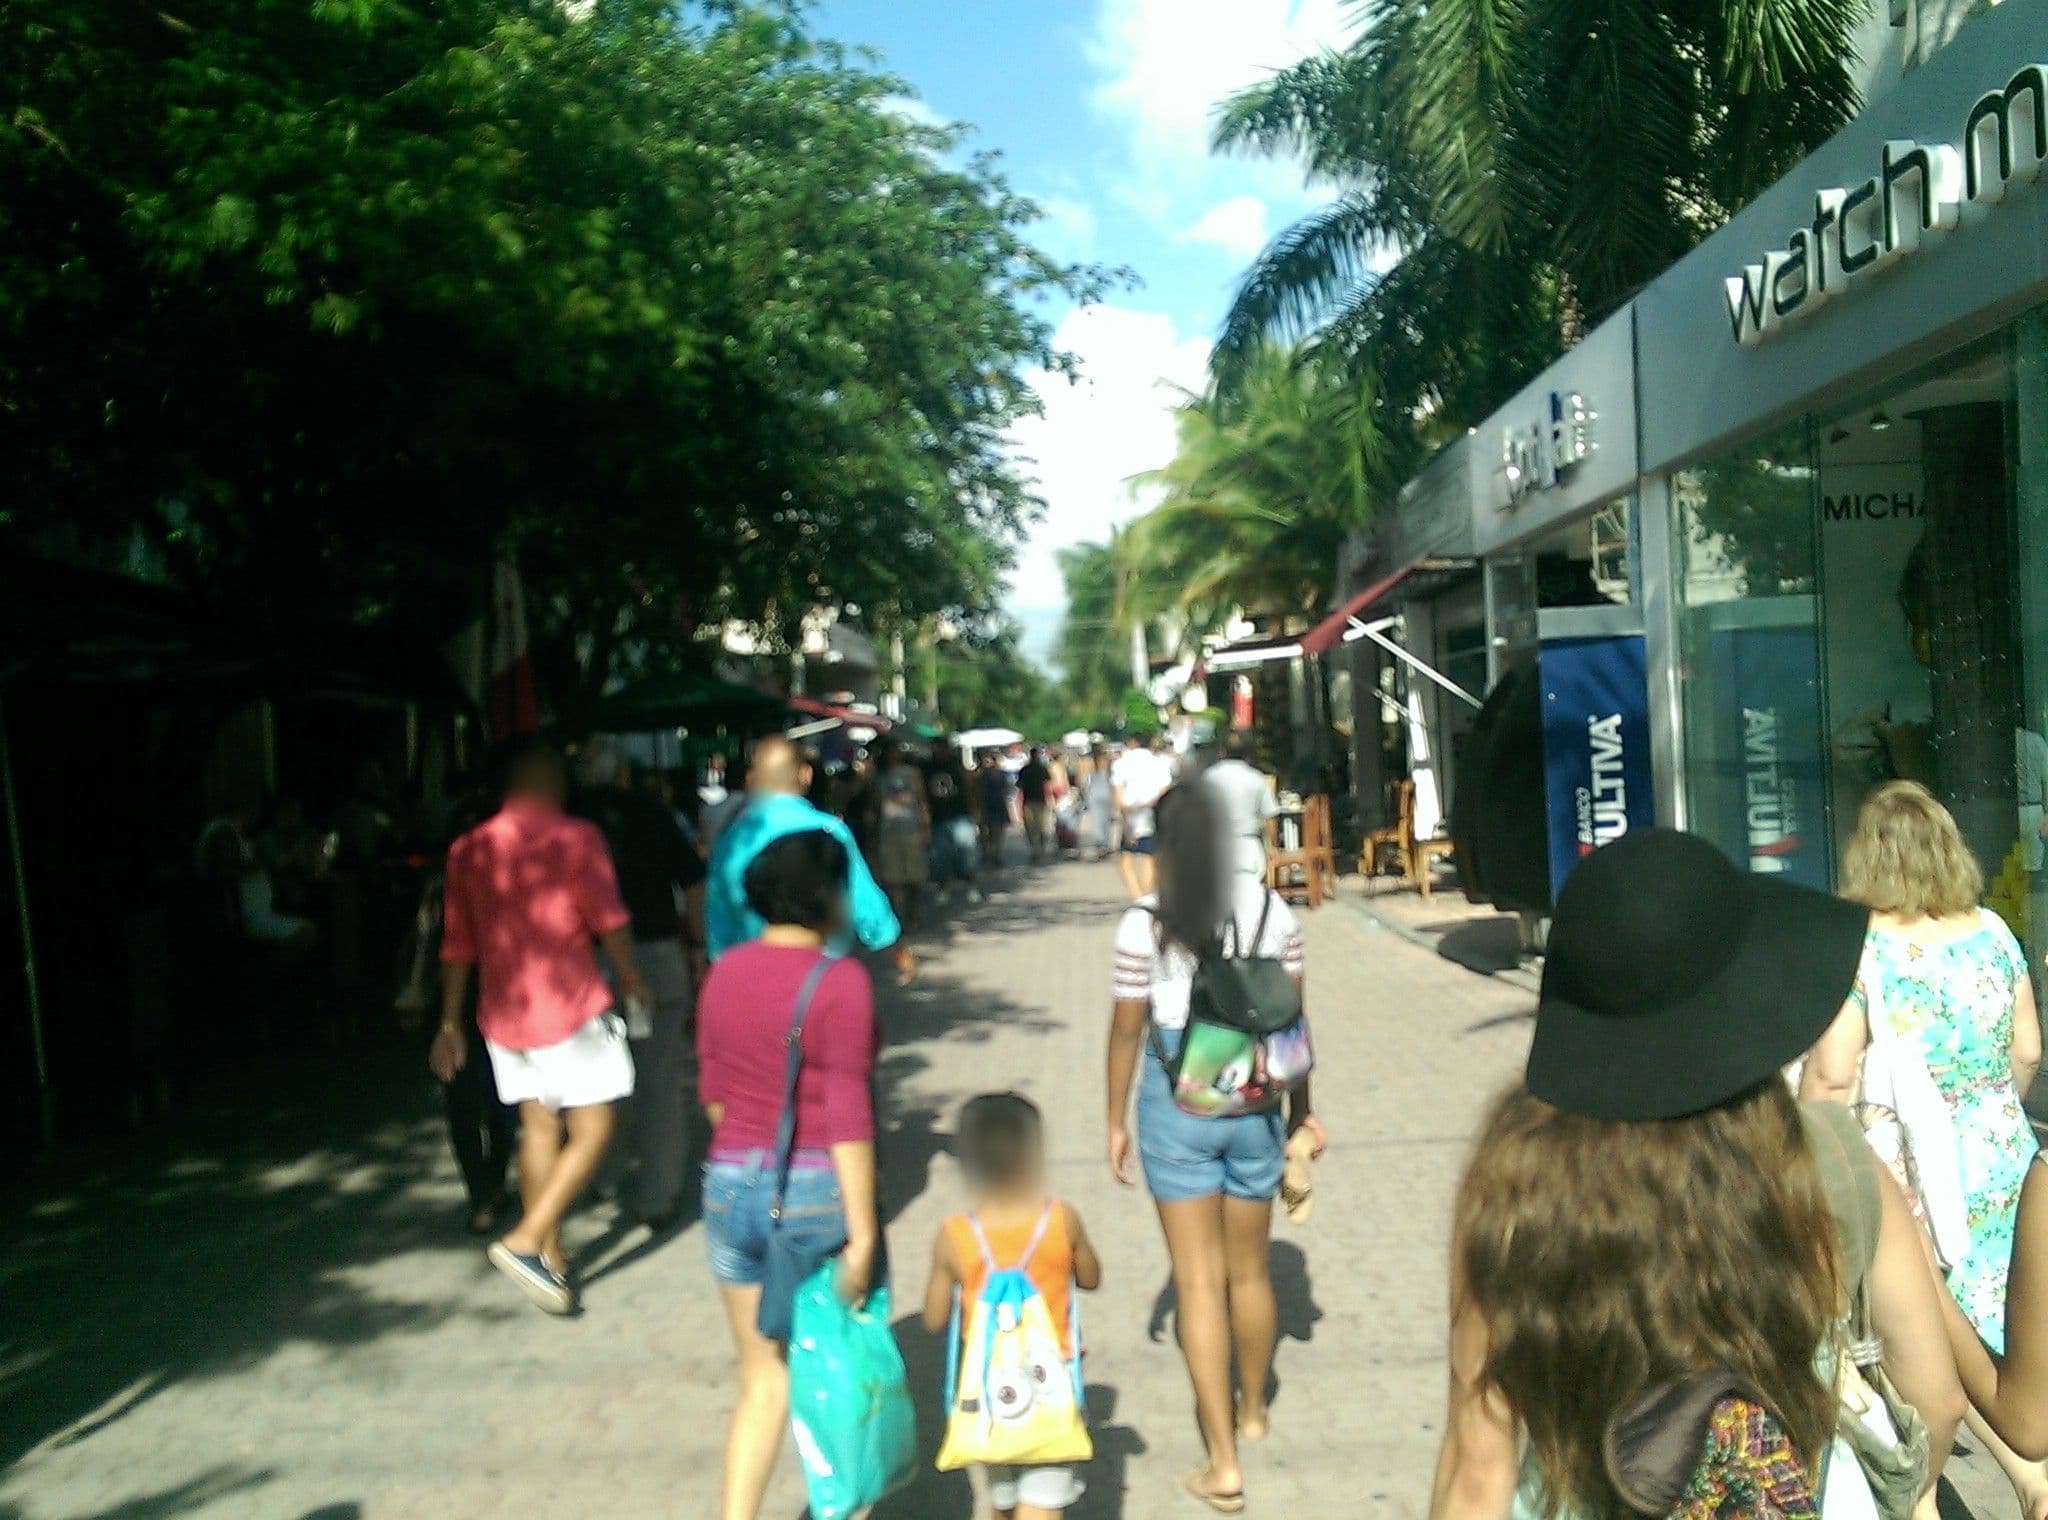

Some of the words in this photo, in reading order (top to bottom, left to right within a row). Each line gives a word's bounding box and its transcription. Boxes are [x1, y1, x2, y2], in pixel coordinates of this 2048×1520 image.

[1726, 140, 1944, 345] watch
[1575, 786, 1593, 843] BANCO
[1589, 713, 1628, 847] ULTIVA
